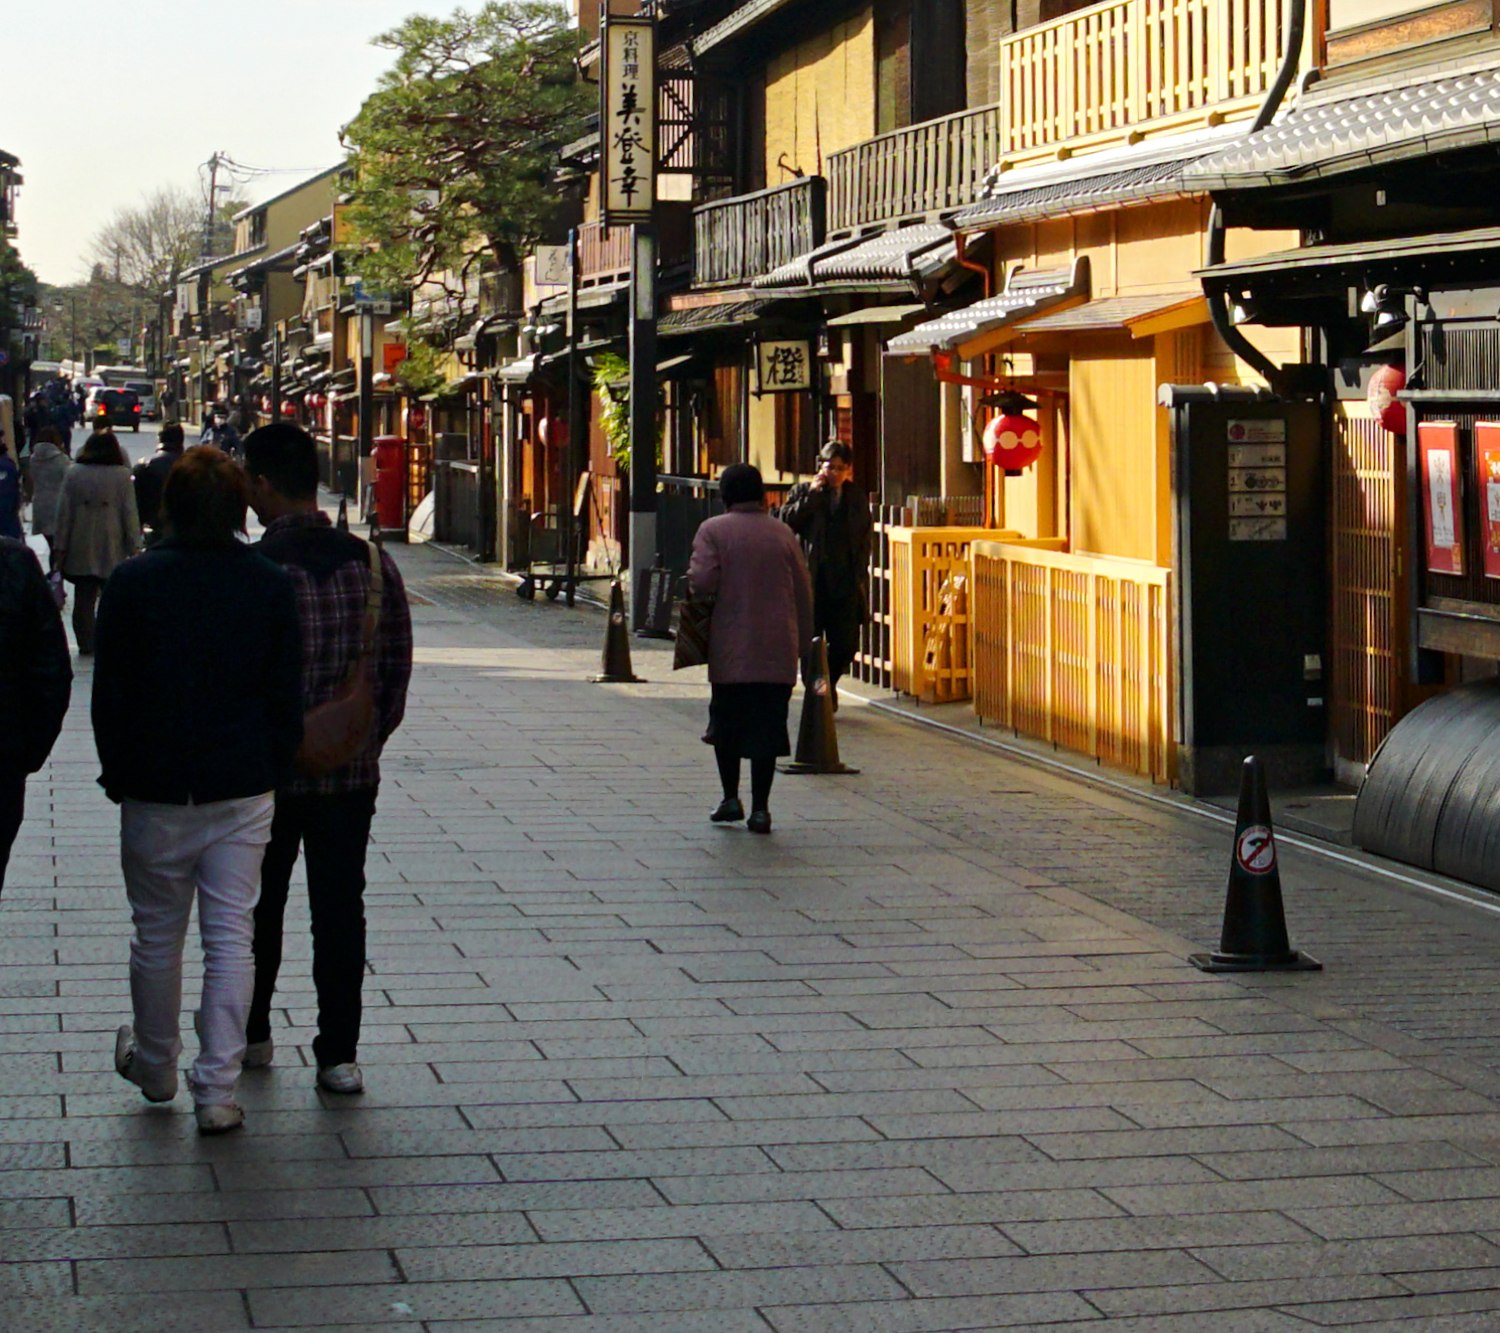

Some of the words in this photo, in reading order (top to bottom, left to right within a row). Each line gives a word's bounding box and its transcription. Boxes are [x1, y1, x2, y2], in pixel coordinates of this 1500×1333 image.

[621, 30, 640, 80] 京料理
[766, 346, 804, 385] 橙
